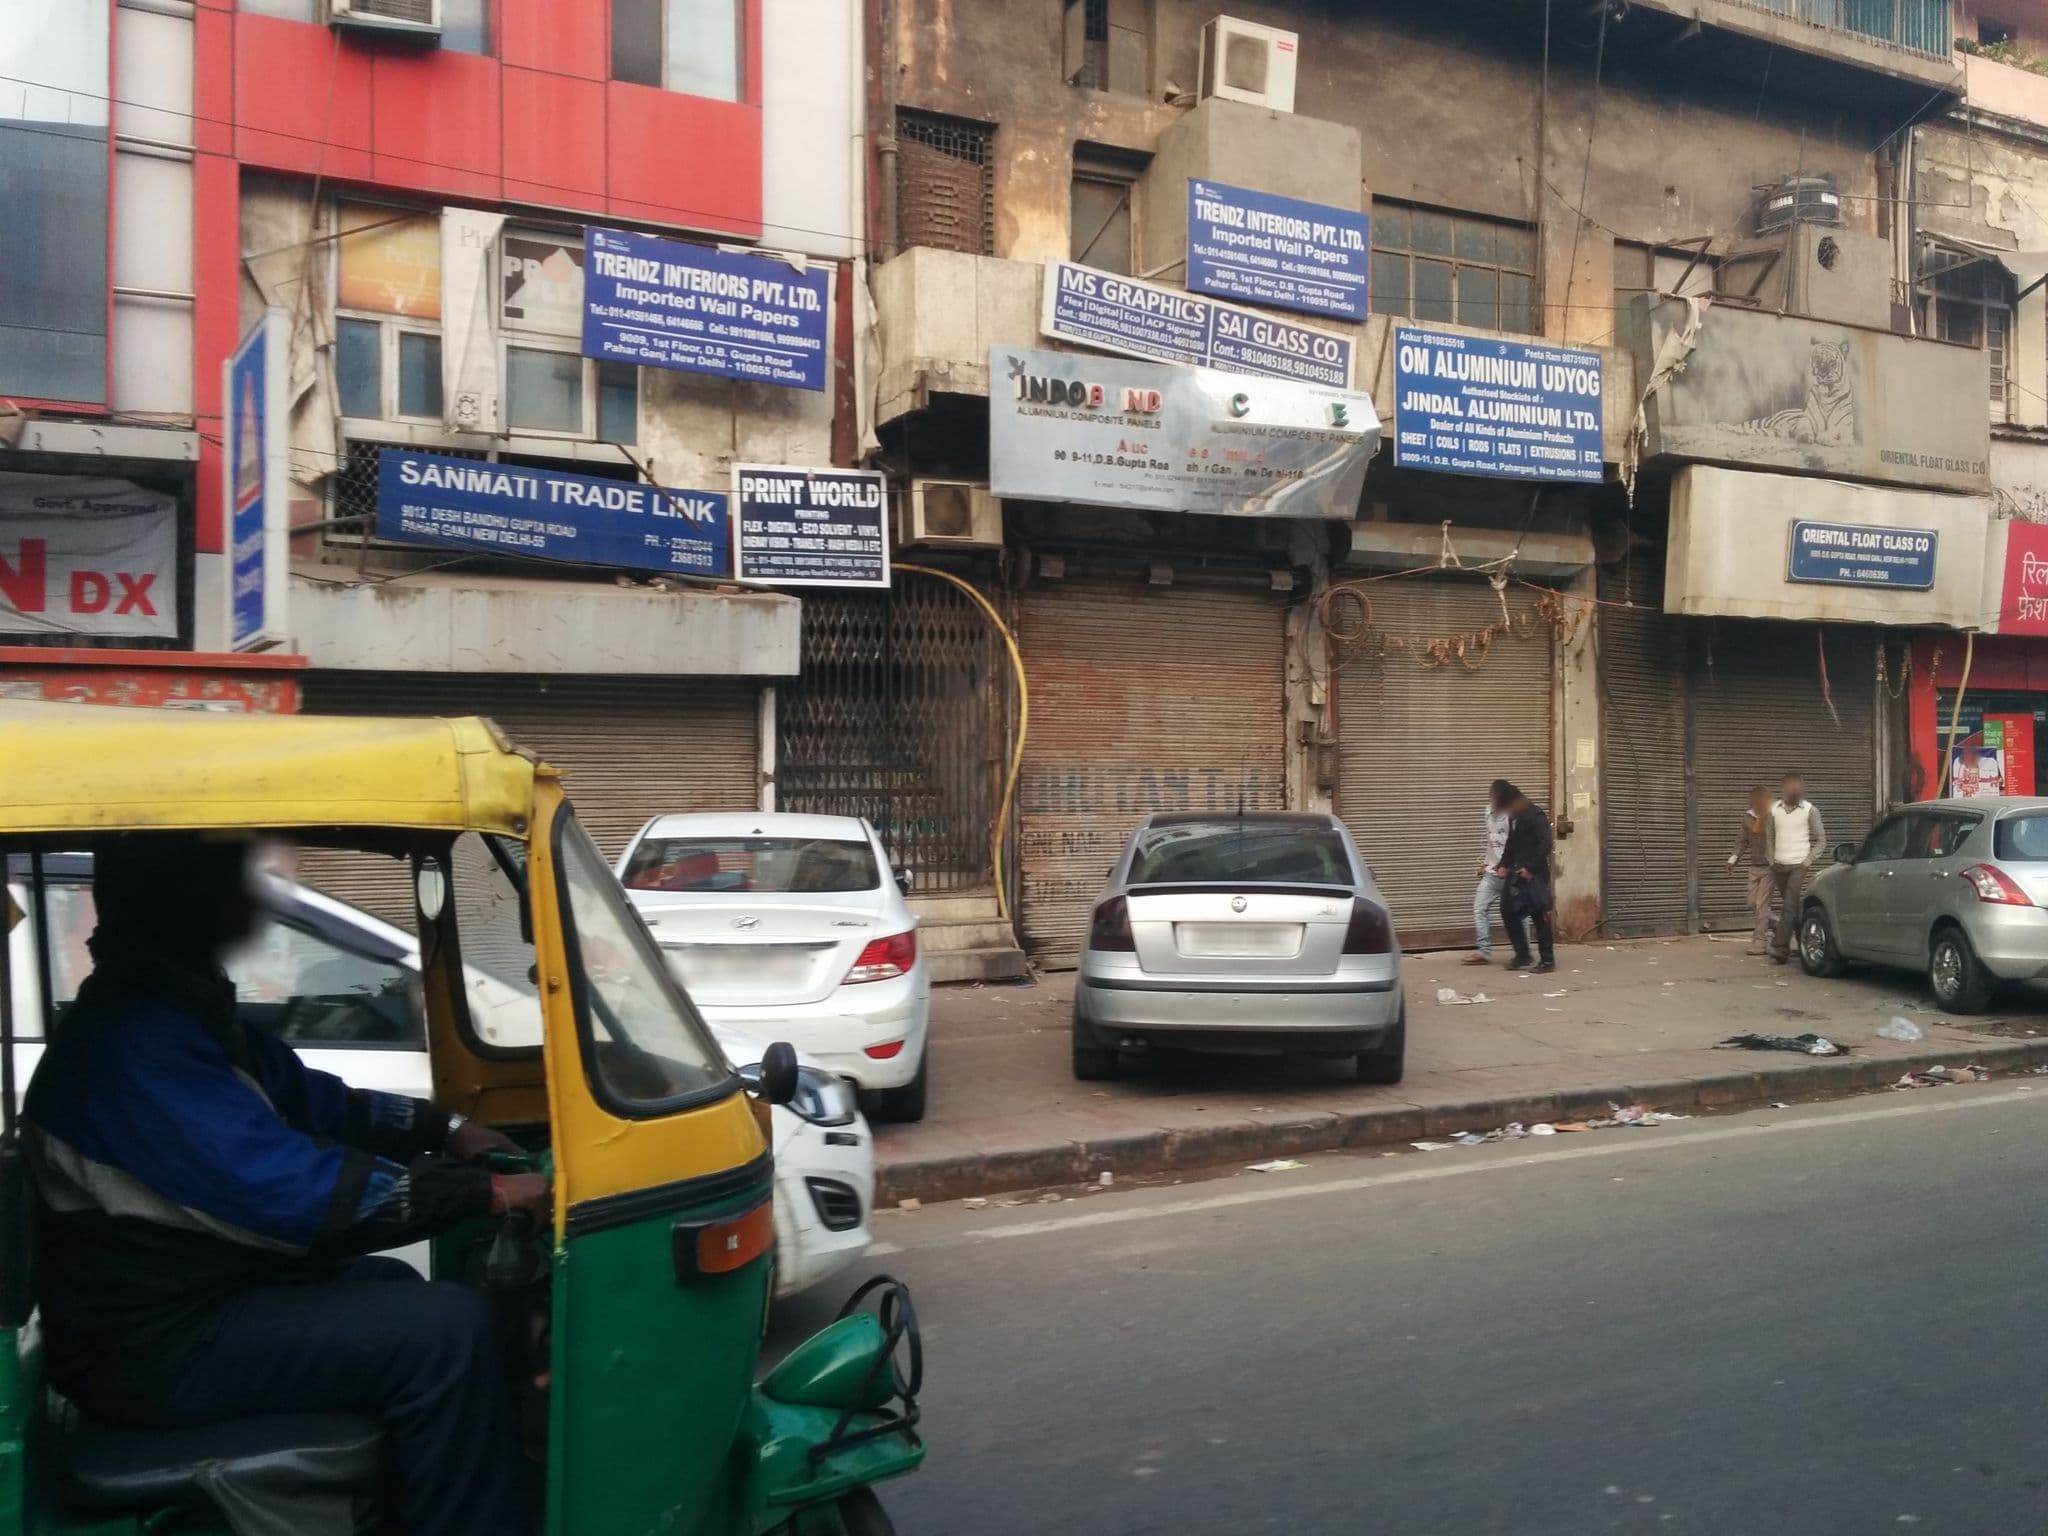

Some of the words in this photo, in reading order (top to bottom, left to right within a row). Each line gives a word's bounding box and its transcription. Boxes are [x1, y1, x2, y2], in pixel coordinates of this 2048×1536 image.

[1195, 199, 1245, 228] TRENDZ
[1247, 210, 1310, 241] INTERIORS
[1313, 223, 1337, 246] PVT.
[1212, 226, 1271, 250] Imported
[1275, 238, 1302, 256] Wall
[1305, 245, 1349, 266] Papers
[593, 251, 660, 284] TRENDZ
[664, 263, 749, 300] INTERIORS
[753, 280, 785, 307] PVT.
[788, 286, 821, 312] LTD.
[1062, 269, 1097, 296] MS
[1101, 279, 1206, 323] GRAPHICS
[1205, 277, 1229, 289] Pahar
[1255, 287, 1272, 297] New
[1274, 290, 1295, 301] Delhi
[1330, 300, 1355, 312] (India)
[1240, 274, 1253, 284] 1st
[1279, 281, 1296, 291] D.B.
[1298, 285, 1322, 298] Gupta
[1323, 289, 1345, 300] Road
[616, 283, 695, 311] Imported
[700, 297, 736, 318] Wall
[741, 304, 800, 330] Papers
[1064, 295, 1083, 308] Flex
[1089, 302, 1119, 319] Digital
[1124, 313, 1140, 323] Eco
[1146, 317, 1165, 329] ACP
[1166, 322, 1201, 338] Signage
[653, 337, 670, 348] 1st
[705, 346, 728, 357] D.B.
[730, 350, 762, 363] Gupta
[764, 355, 792, 367] Road
[1213, 340, 1240, 360] Cont.:
[1217, 311, 1247, 340] SAI
[1252, 321, 1308, 356] GLASS
[1312, 339, 1343, 364] CO.
[604, 341, 637, 355] Pahar
[639, 347, 668, 362] Ganj,
[671, 352, 695, 365] New
[697, 355, 725, 369] Delhi
[772, 368, 806, 382] (India)
[1400, 344, 1429, 376] OM
[1433, 350, 1537, 389] ALUMINIUM
[1541, 364, 1600, 397] UDYOG
[1402, 391, 1463, 417] JINDAL
[1467, 399, 1561, 428] ALUMINIUM
[1565, 410, 1599, 431] LTD.
[1530, 395, 1540, 403] of
[1017, 405, 1069, 420] ALUMINIUM
[1070, 411, 1124, 426] COMPOSITE
[1127, 417, 1161, 430] PANELS
[1430, 418, 1454, 431] Dealer
[1455, 422, 1463, 433] of
[1464, 422, 1474, 434] All
[1475, 423, 1496, 436] Kinds
[1496, 426, 1505, 437] of
[1505, 427, 1542, 440] Aluminium
[1543, 431, 1574, 444] Products
[1269, 428, 1326, 443] COMPOSITE
[1401, 431, 1427, 446] SHEET
[1436, 435, 1459, 450] COILS
[1468, 438, 1489, 453] RODS
[1498, 442, 1521, 456] FLATS
[1530, 445, 1577, 461] EXTRUSIONS
[1584, 450, 1601, 463] ETC.
[1434, 456, 1450, 465] D.B.
[1451, 458, 1474, 469] Gupta
[1539, 466, 1555, 475] New
[1880, 450, 1919, 467] ORIENTAL
[1920, 456, 1943, 471] FLOAT
[1945, 459, 1970, 473] GLASS
[1972, 460, 1986, 475] CO
[399, 460, 538, 500] SANMATI
[546, 480, 644, 513] TRADE
[652, 494, 716, 524] LINK
[741, 477, 804, 505] PRINT
[808, 481, 880, 508] WORLD
[401, 519, 440, 535] PAHAR
[441, 524, 472, 538] GANJ
[472, 527, 499, 541] NEW
[499, 530, 545, 548] DELHI-55
[431, 508, 462, 523] DESH
[463, 511, 509, 528] BANDHU
[510, 518, 545, 534] GUPTA
[547, 523, 577, 538] ROAD
[1802, 528, 1850, 546] ORIENTAL
[1852, 532, 1881, 548] FLOAT
[1883, 535, 1914, 551] GLASS
[1915, 537, 1929, 552] CO
[70, 570, 158, 616] DX
